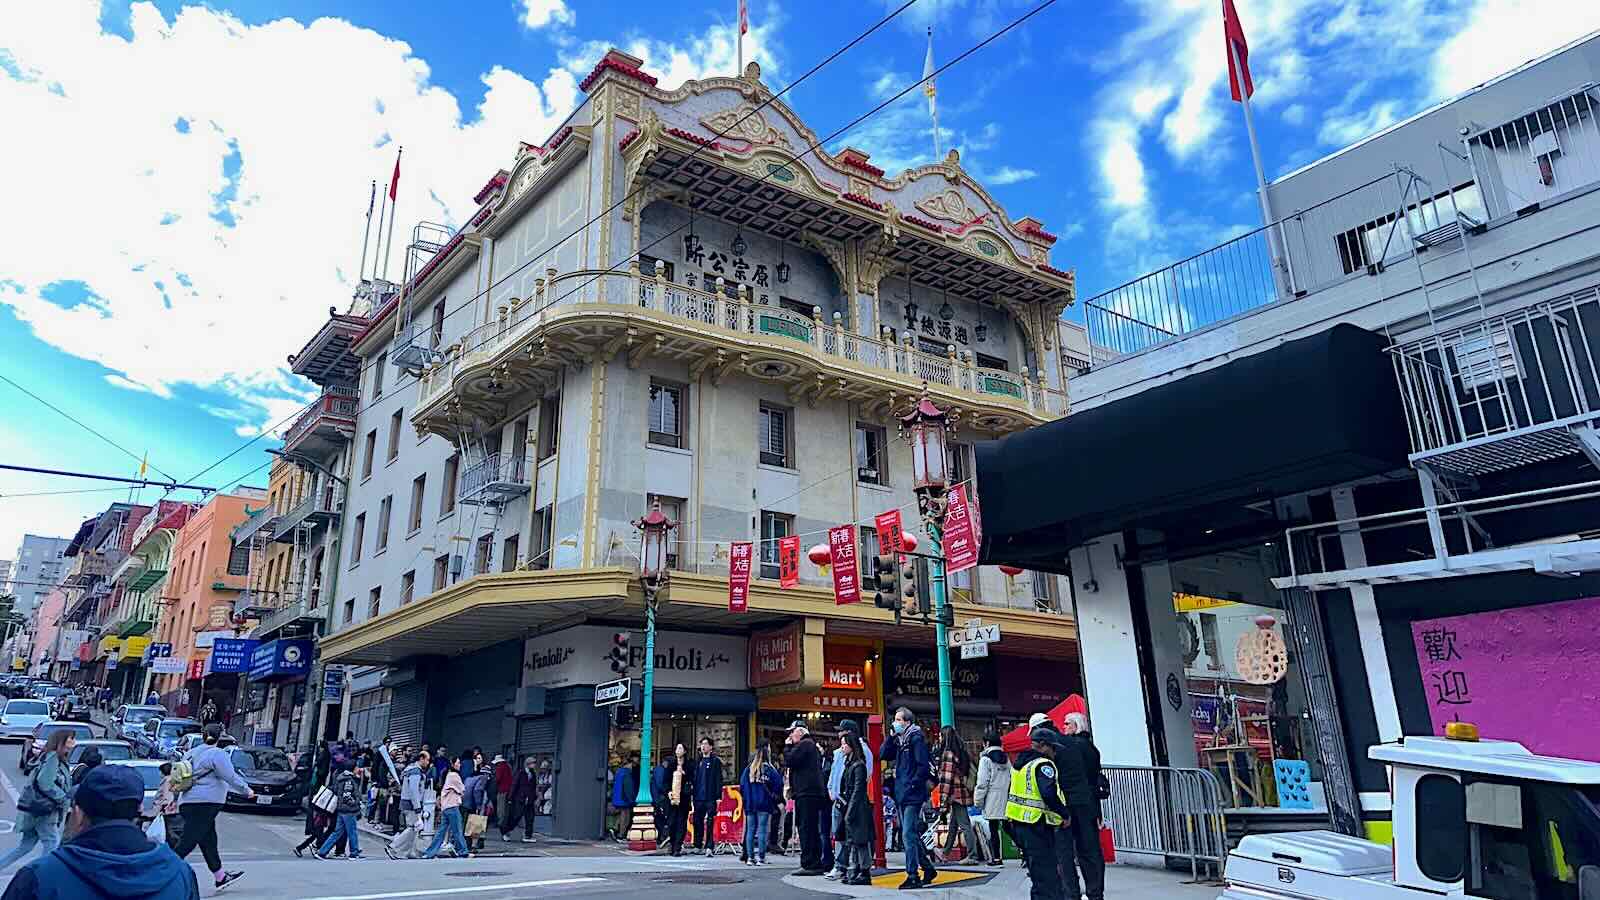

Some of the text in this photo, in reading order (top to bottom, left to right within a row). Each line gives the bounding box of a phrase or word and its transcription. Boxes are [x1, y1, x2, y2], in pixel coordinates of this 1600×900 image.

[944, 503, 965, 524] 大吉
[831, 528, 849, 544] 新春
[836, 544, 853, 559] 大吉
[734, 558, 749, 571] 大吉
[953, 627, 993, 642] CLAY
[216, 657, 241, 666] PAIN
[628, 645, 704, 671] Fnloli
[761, 654, 786, 673] Mart
[829, 668, 862, 685] Mart
[1421, 627, 1473, 729] 歡迎
[598, 685, 620, 700] ONE WAY
